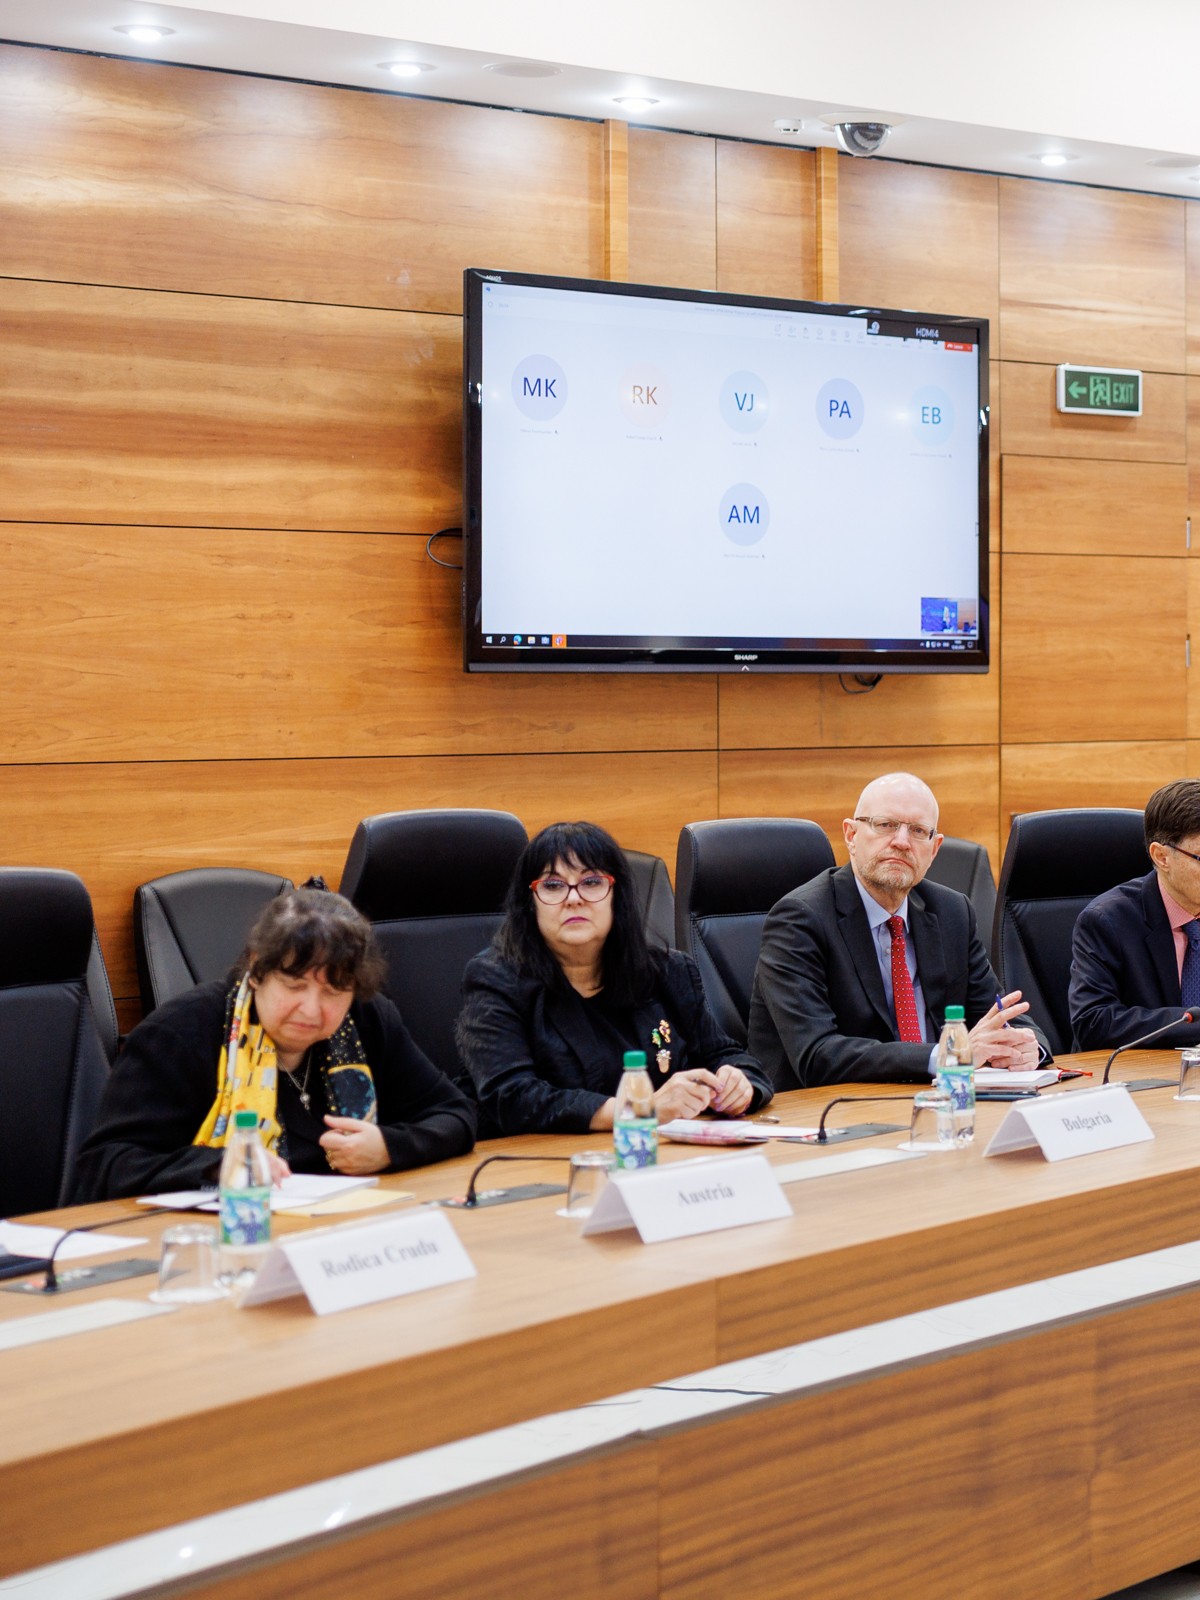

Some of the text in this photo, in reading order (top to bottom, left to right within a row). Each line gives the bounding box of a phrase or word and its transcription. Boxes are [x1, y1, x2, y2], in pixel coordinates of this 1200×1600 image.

[915, 328, 939, 338] HDMI4
[522, 376, 557, 399] MK
[631, 385, 658, 406] RK
[1112, 382, 1135, 404] EXIT
[734, 392, 755, 413] VJ
[828, 399, 852, 420] PA
[921, 406, 942, 425] EB
[728, 505, 760, 525] AM
[1061, 1111, 1112, 1133] Bulgaria
[678, 1182, 735, 1208] Austria
[321, 1238, 439, 1279] Rodica Crudu
